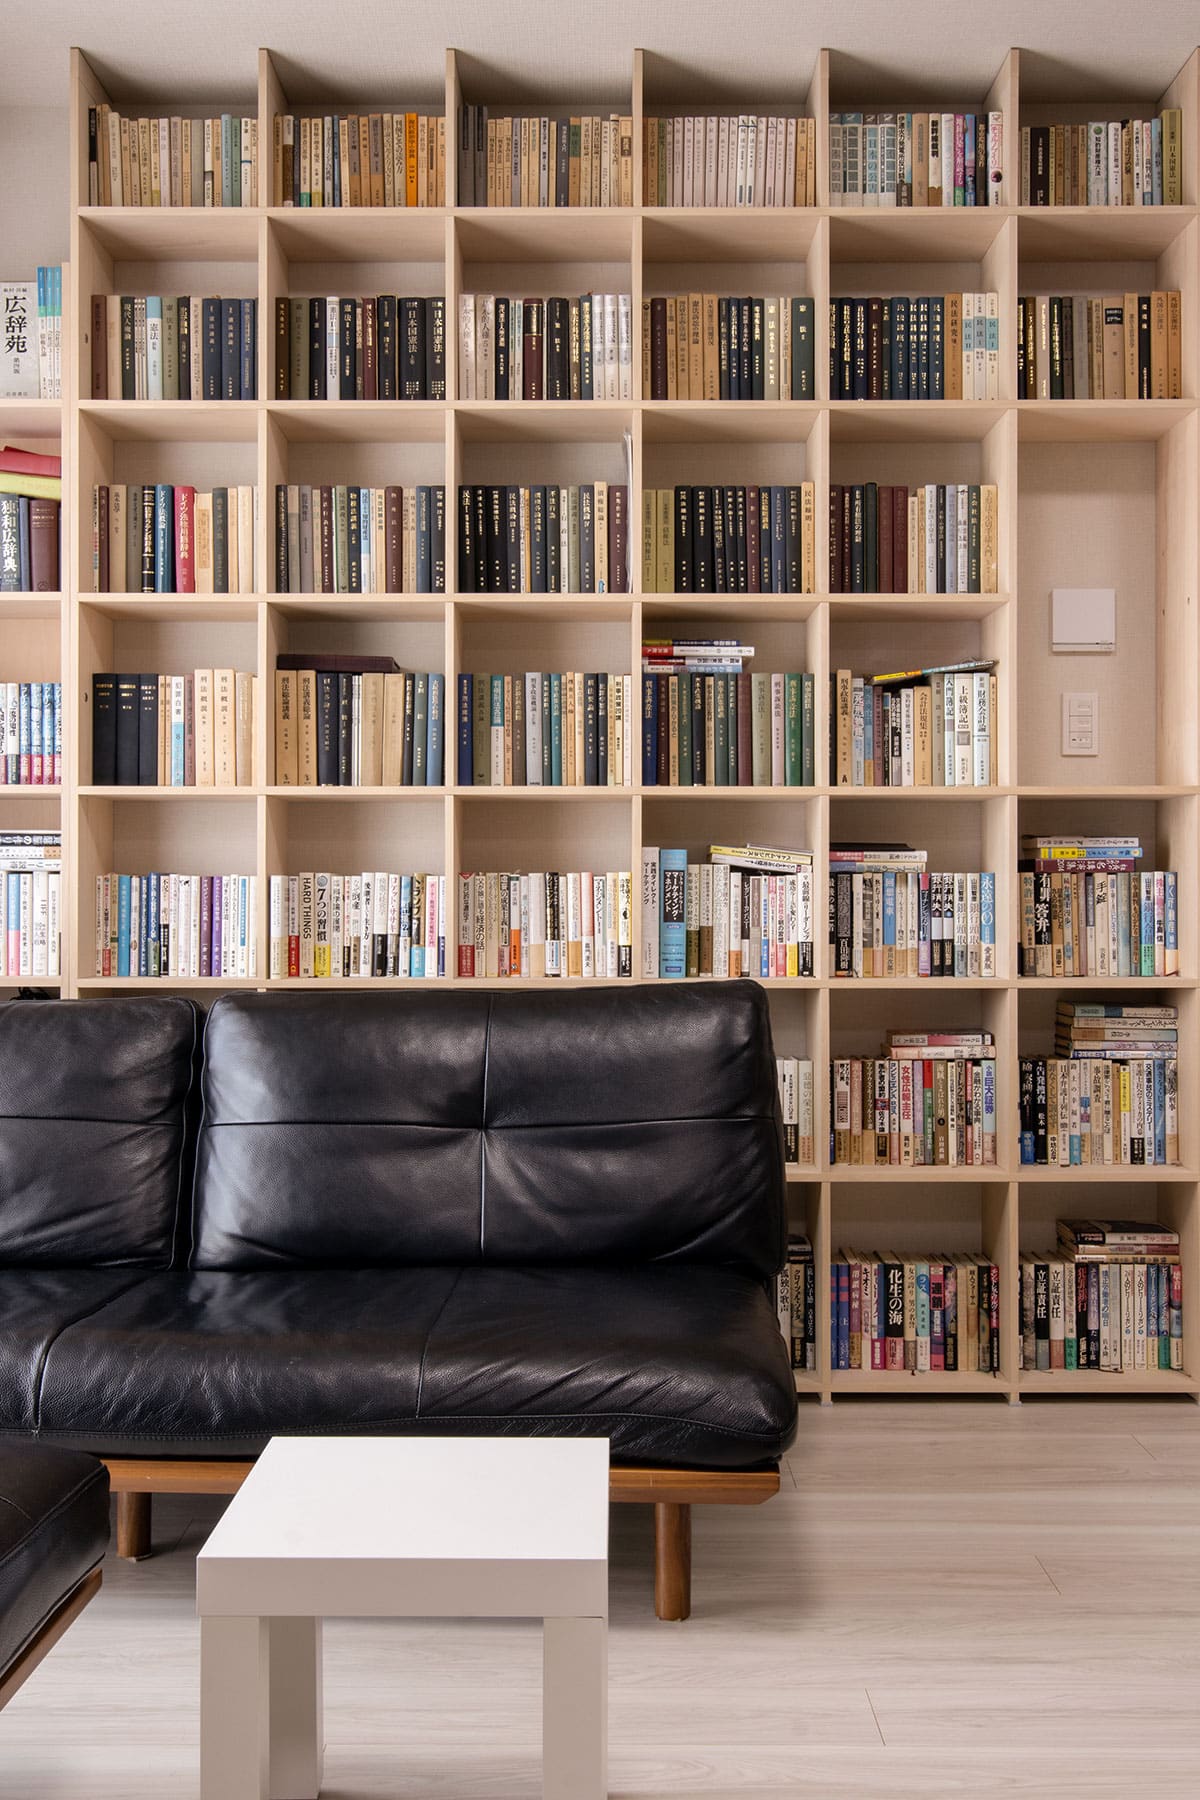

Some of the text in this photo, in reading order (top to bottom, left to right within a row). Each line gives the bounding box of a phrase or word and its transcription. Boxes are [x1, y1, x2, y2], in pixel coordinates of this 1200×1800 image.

[5, 296, 27, 354] 広辞苑
[408, 310, 417, 352] 日本国憲法
[434, 310, 443, 352] 日本国憲法
[946, 679, 954, 716] 入門簿記
[958, 686, 968, 724] 上級簿記
[977, 690, 986, 733] 財務会計論
[303, 878, 311, 939] HARD THINGS
[317, 888, 328, 942] 7つの習慣
[901, 1066, 911, 1120] 女性広報主任
[985, 1077, 994, 1114] 巨大証券
[889, 1269, 903, 1325] 化生の海
[1037, 1270, 1047, 1319] 立証責任
[1052, 1270, 1061, 1319] 立証責任
